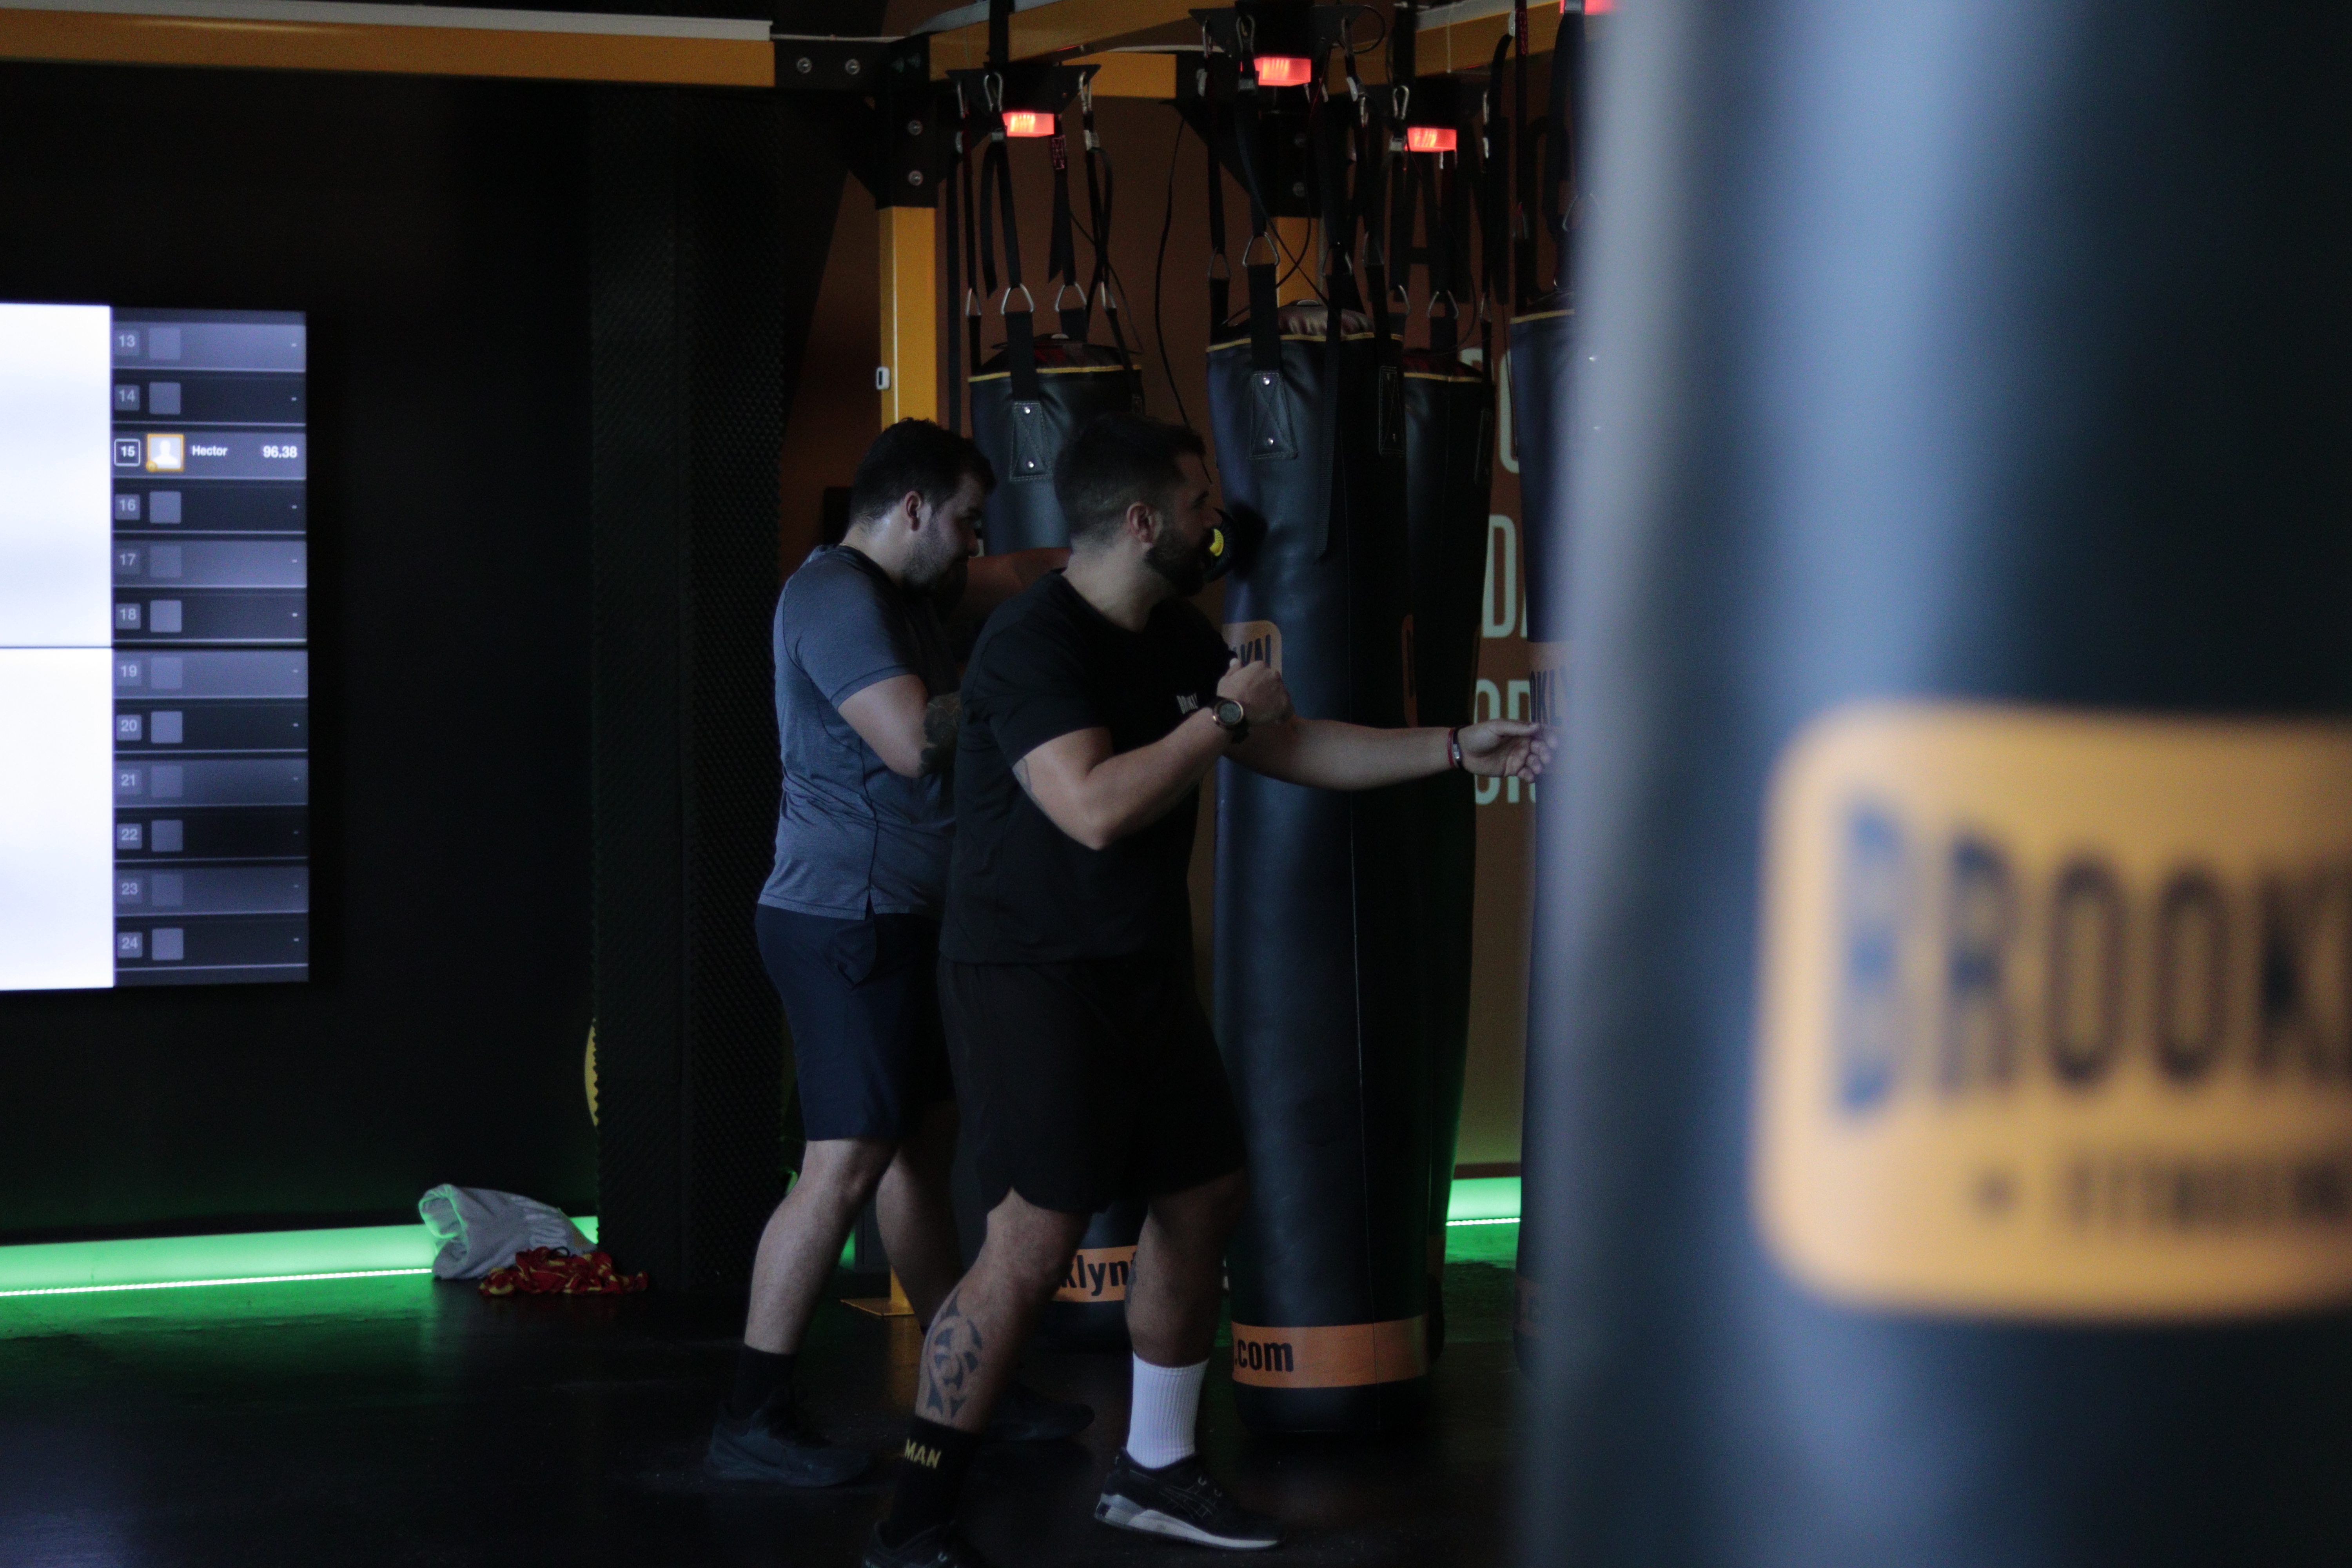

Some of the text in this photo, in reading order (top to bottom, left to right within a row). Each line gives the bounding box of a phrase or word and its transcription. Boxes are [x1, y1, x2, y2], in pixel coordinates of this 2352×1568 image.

[119, 335, 135, 348] 13
[119, 390, 135, 403] 14
[121, 445, 298, 459] 15 Hector 96.38
[120, 498, 136, 512] 16
[119, 553, 136, 566] 17
[120, 608, 136, 621] 18
[120, 665, 137, 677] 19
[120, 719, 137, 732] 20
[121, 774, 136, 787] 21
[121, 828, 138, 841] 22
[121, 883, 138, 896] 23
[121, 937, 139, 950] 24
[1059, 1251, 1136, 1296] klyn
[1235, 1339, 1294, 1372] .com
